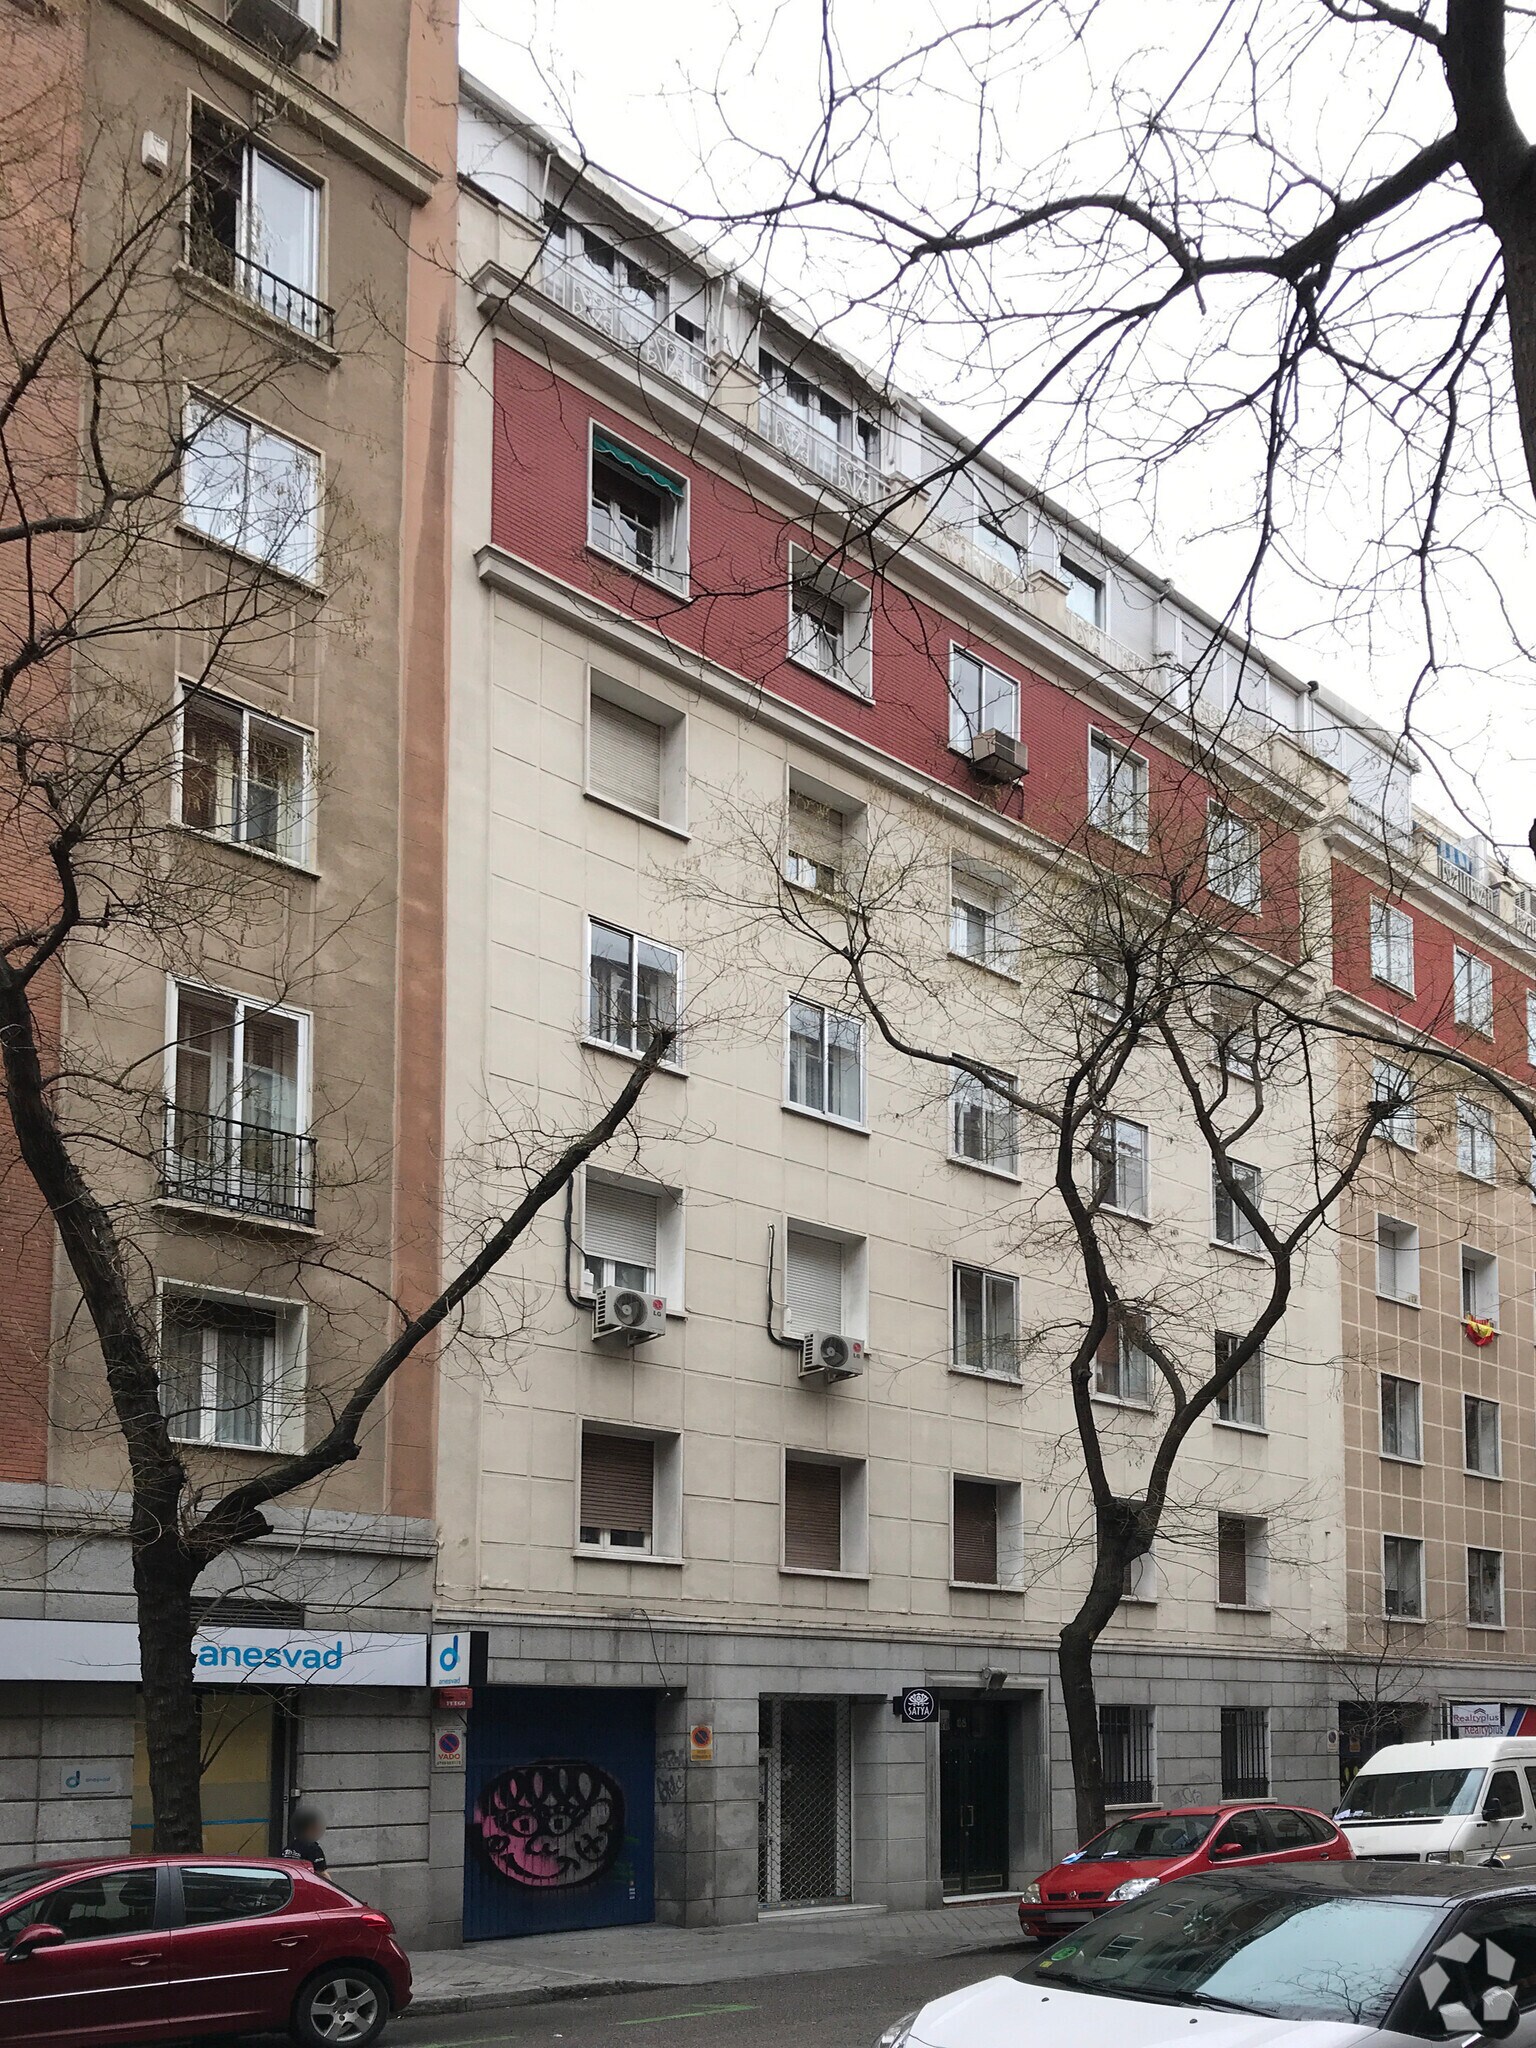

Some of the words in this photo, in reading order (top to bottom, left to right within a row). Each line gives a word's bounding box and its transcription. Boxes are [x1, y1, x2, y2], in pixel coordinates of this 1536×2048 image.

[198, 1640, 343, 1670] anesvad
[907, 1706, 930, 1716] SATYA
[1453, 1713, 1500, 1723] Realtyplus
[1464, 1725, 1504, 1736] Realtyplus
